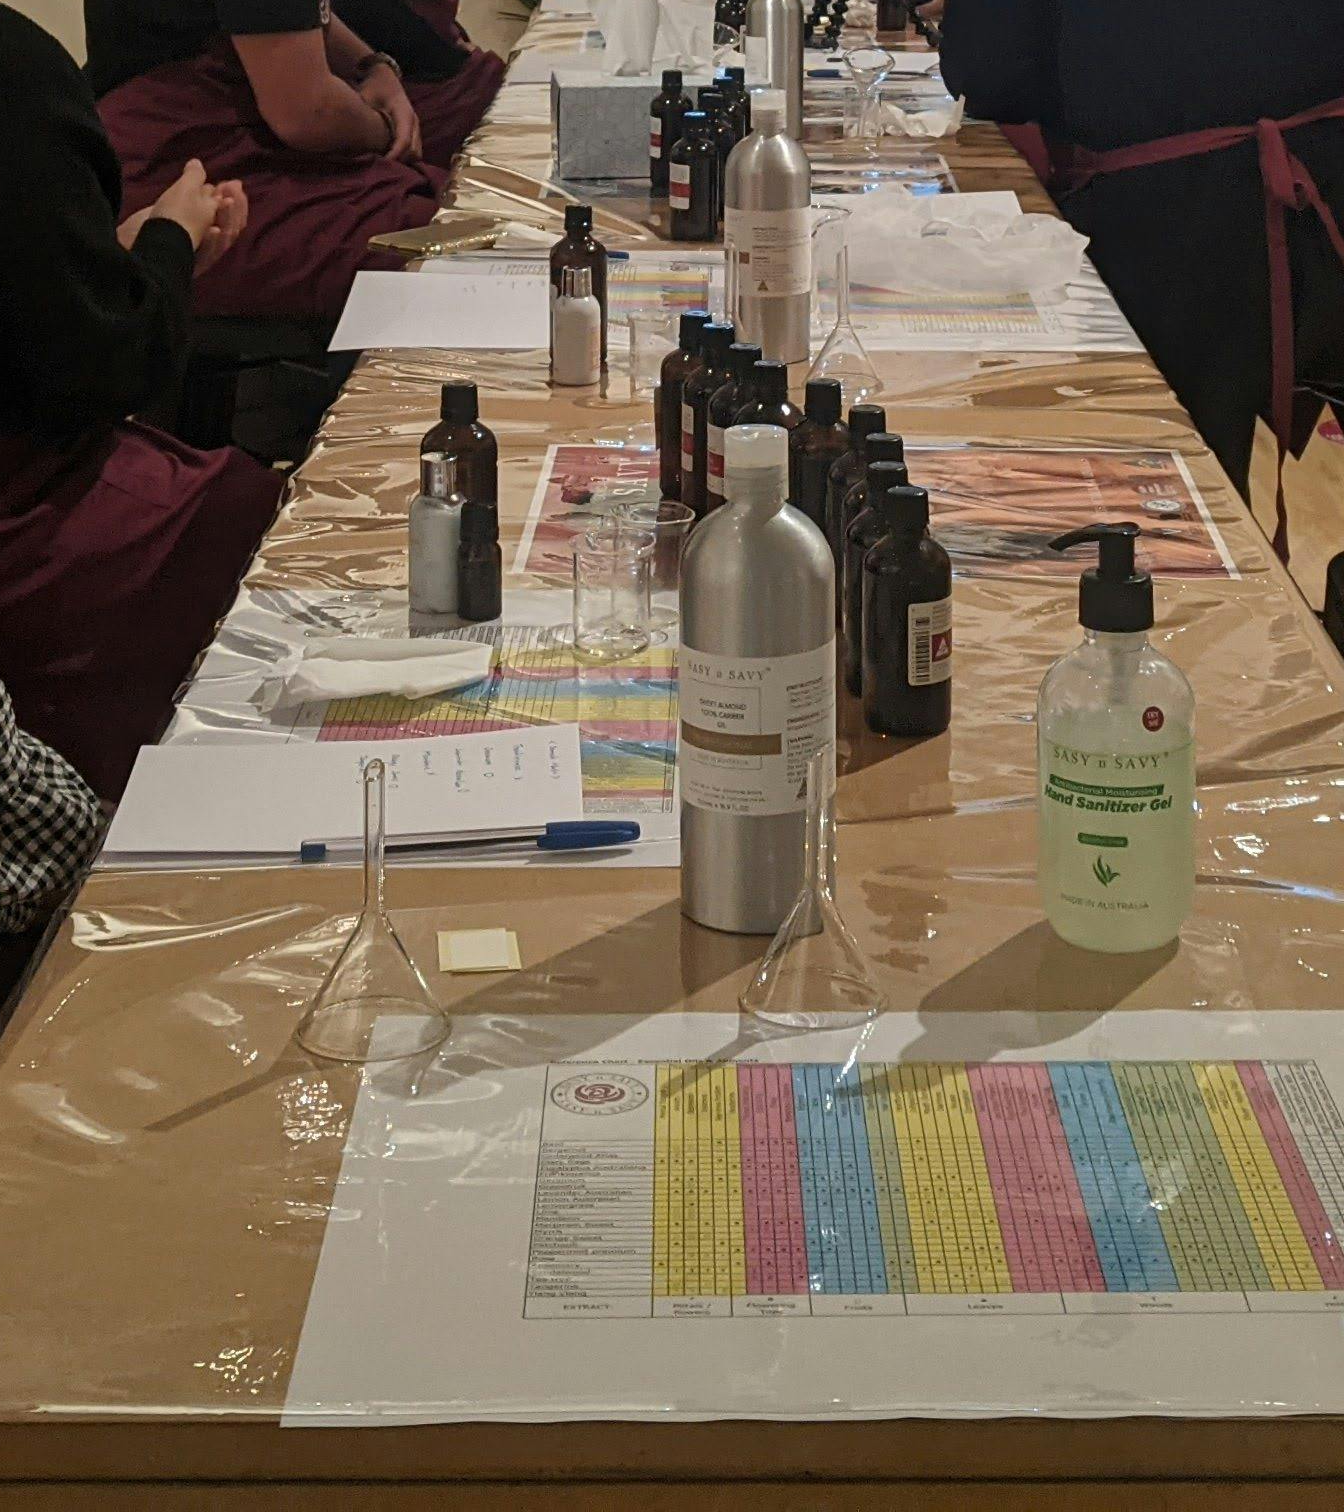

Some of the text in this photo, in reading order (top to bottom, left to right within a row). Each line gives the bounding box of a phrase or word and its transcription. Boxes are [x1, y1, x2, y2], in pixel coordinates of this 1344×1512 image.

[1053, 747, 1091, 767] SASY
[1044, 783, 1173, 813] Hand Sanitizer Gel
